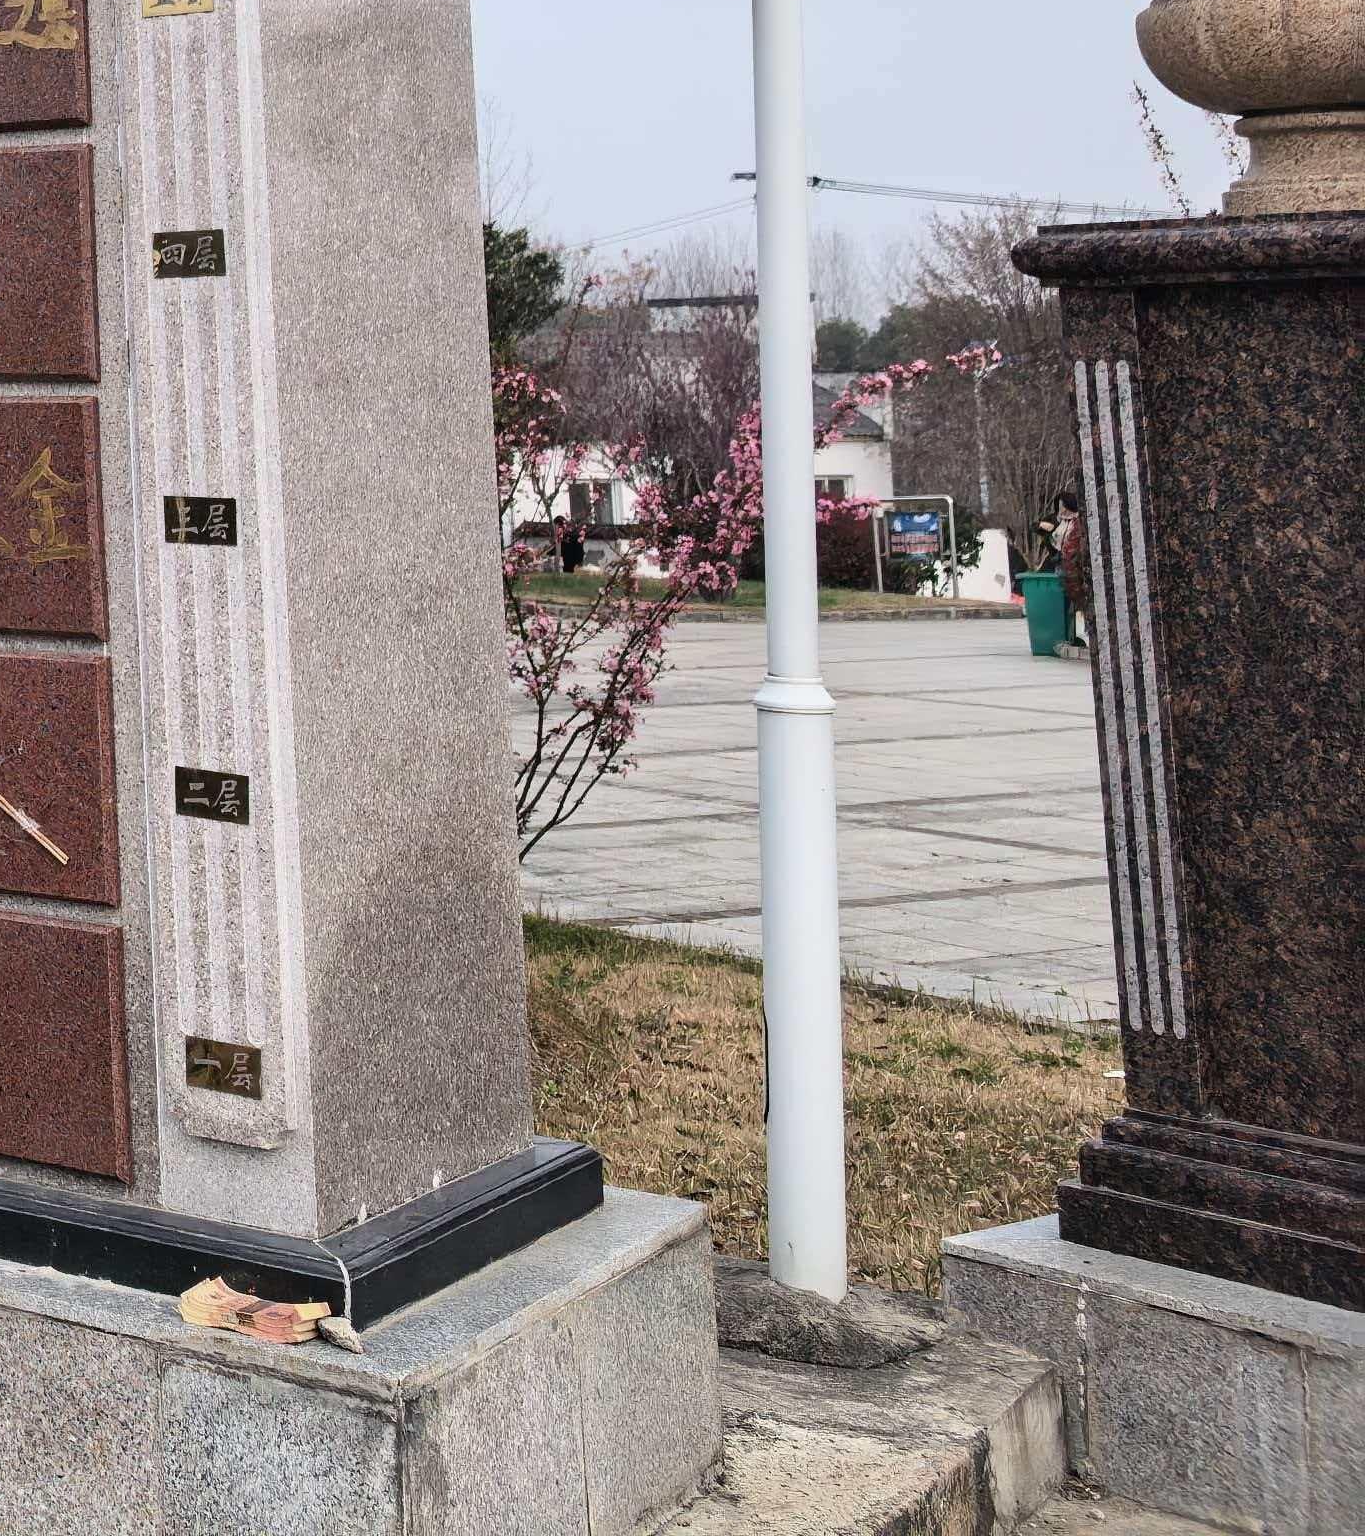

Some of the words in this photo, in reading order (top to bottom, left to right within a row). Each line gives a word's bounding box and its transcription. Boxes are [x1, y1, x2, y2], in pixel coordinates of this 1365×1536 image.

[161, 235, 217, 270] 四层
[183, 779, 240, 817] 二层
[194, 1053, 253, 1090] 一层
